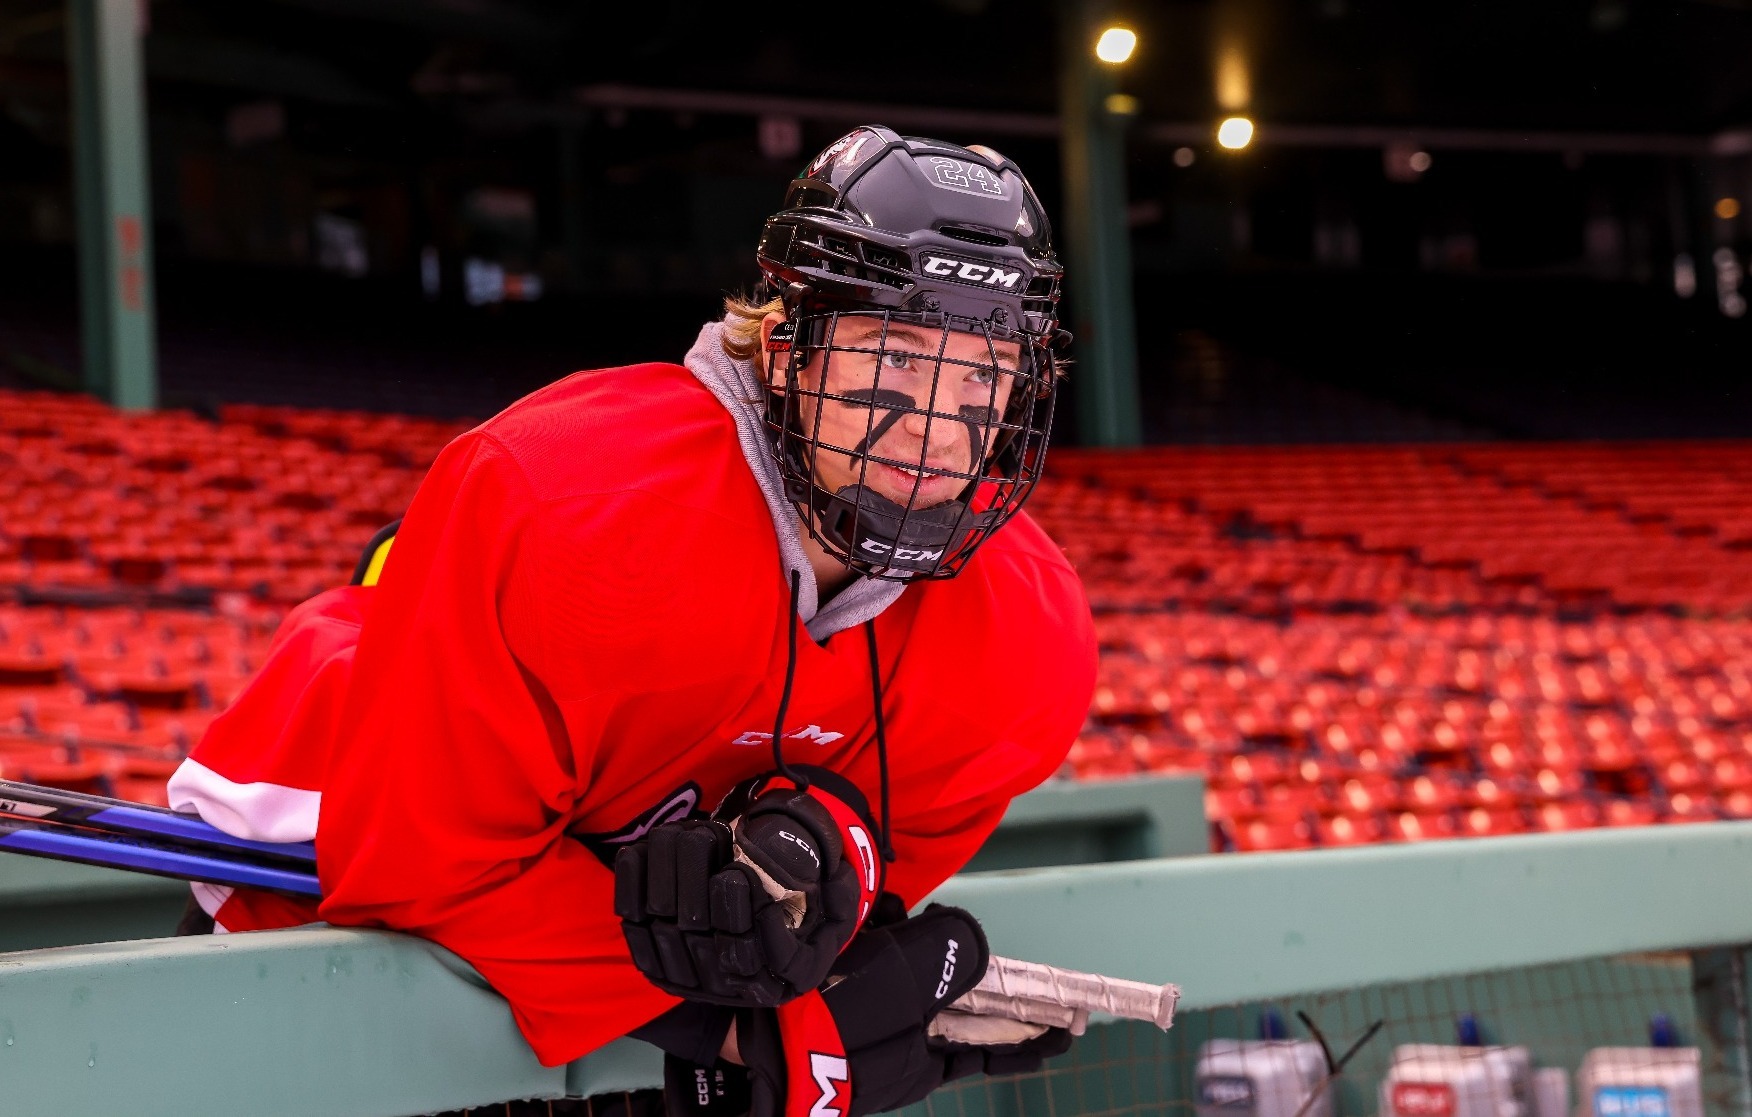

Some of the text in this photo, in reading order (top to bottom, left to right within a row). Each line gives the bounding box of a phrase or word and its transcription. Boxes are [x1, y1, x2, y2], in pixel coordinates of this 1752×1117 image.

[929, 156, 1002, 195] 24
[923, 256, 1021, 288] CCM
[860, 537, 944, 561] CCM
[731, 724, 845, 746] CM
[935, 938, 959, 999] CCM
[694, 1069, 710, 1106] CCM
